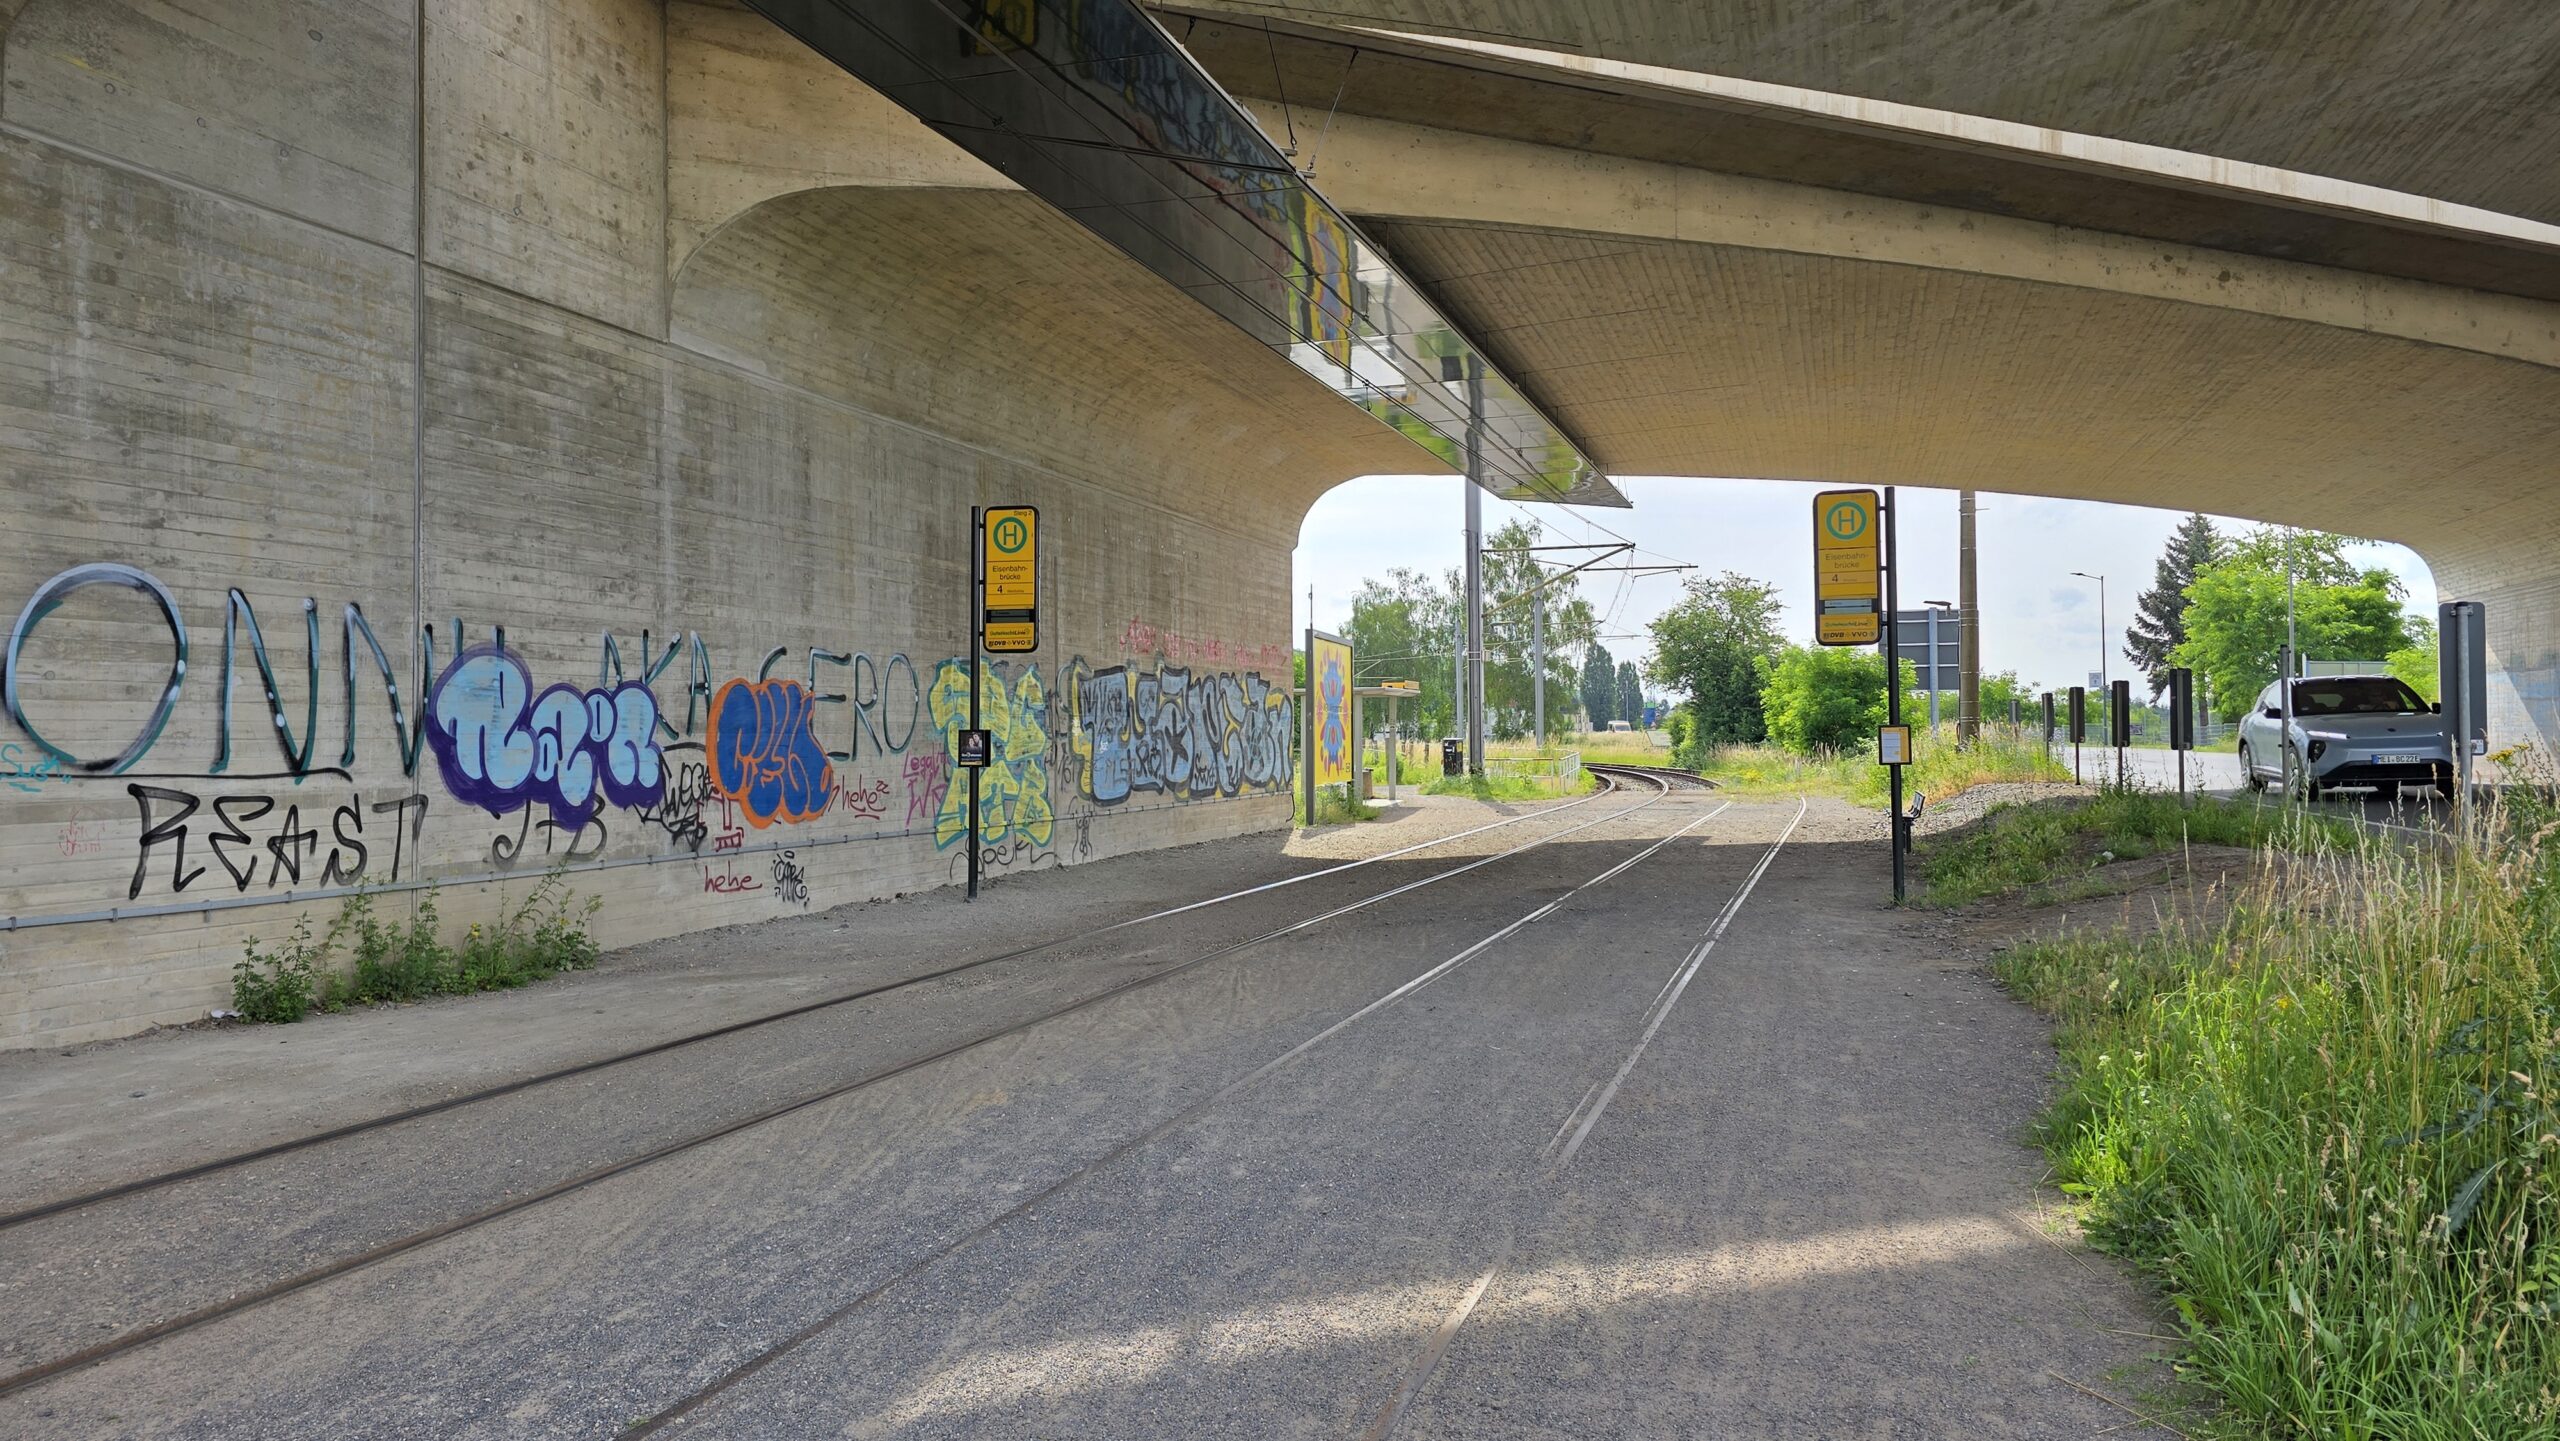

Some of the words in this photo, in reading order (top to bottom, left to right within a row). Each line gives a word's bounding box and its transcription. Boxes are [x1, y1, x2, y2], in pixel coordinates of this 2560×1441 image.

[1832, 574, 1839, 583] 4
[997, 584, 1003, 594] 4
[704, 860, 763, 892] hehe
